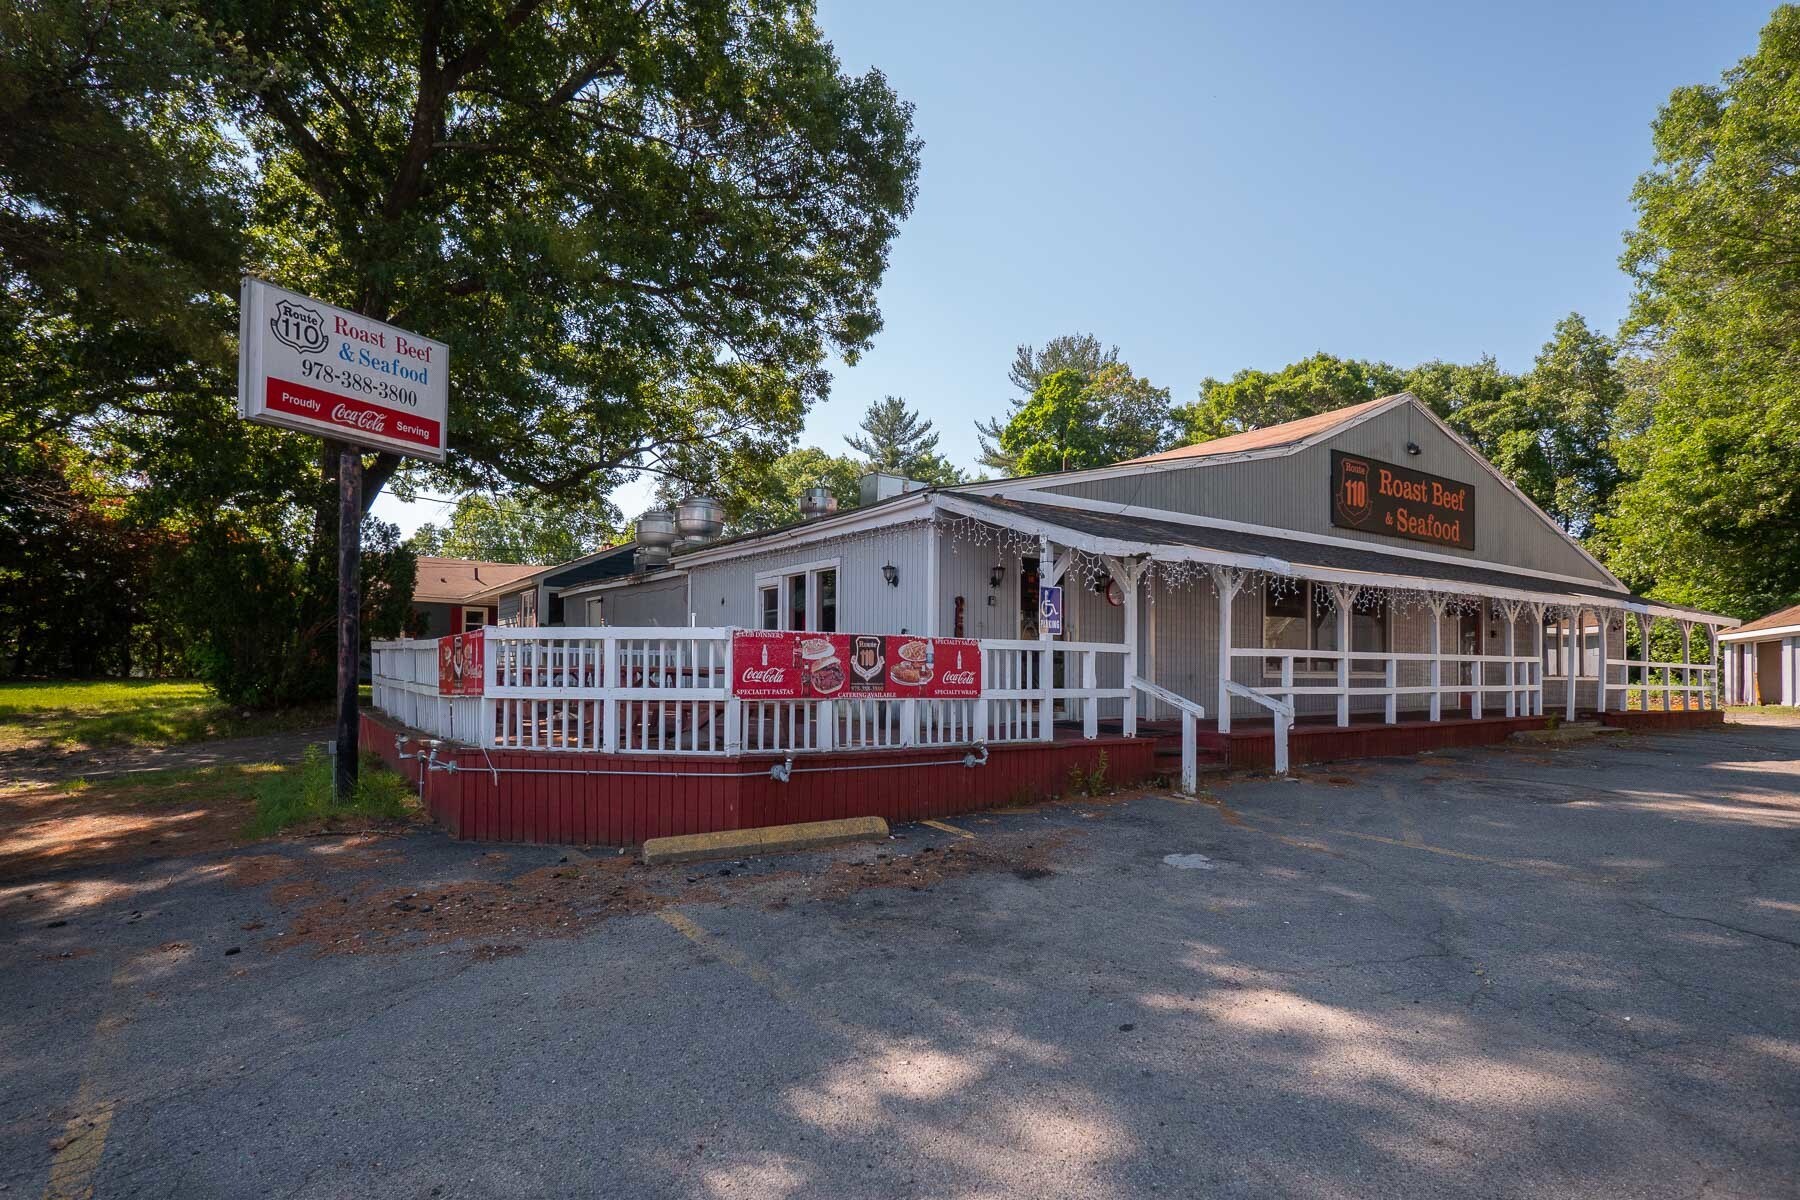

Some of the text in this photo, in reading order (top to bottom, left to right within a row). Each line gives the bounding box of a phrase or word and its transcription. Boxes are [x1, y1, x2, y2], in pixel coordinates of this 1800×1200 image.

[283, 305, 318, 326] Route
[282, 318, 319, 345] 110
[334, 315, 433, 363] Roast Beef
[339, 342, 428, 385] & Seafood
[302, 359, 418, 407] 978-388-3800
[282, 392, 430, 440] Proudly Coca-Cola Serving
[1345, 462, 1366, 475] Route
[1345, 479, 1365, 508] 110
[1379, 469, 1465, 512] Roast Beef
[1385, 508, 1460, 542] & Seafood
[755, 631, 784, 639] DINNERS
[858, 640, 877, 648] Route
[860, 649, 875, 667] 110
[742, 667, 786, 683] Coca-Cola
[942, 670, 977, 685] Coca-Cola
[736, 688, 772, 696] SPECIALTY
